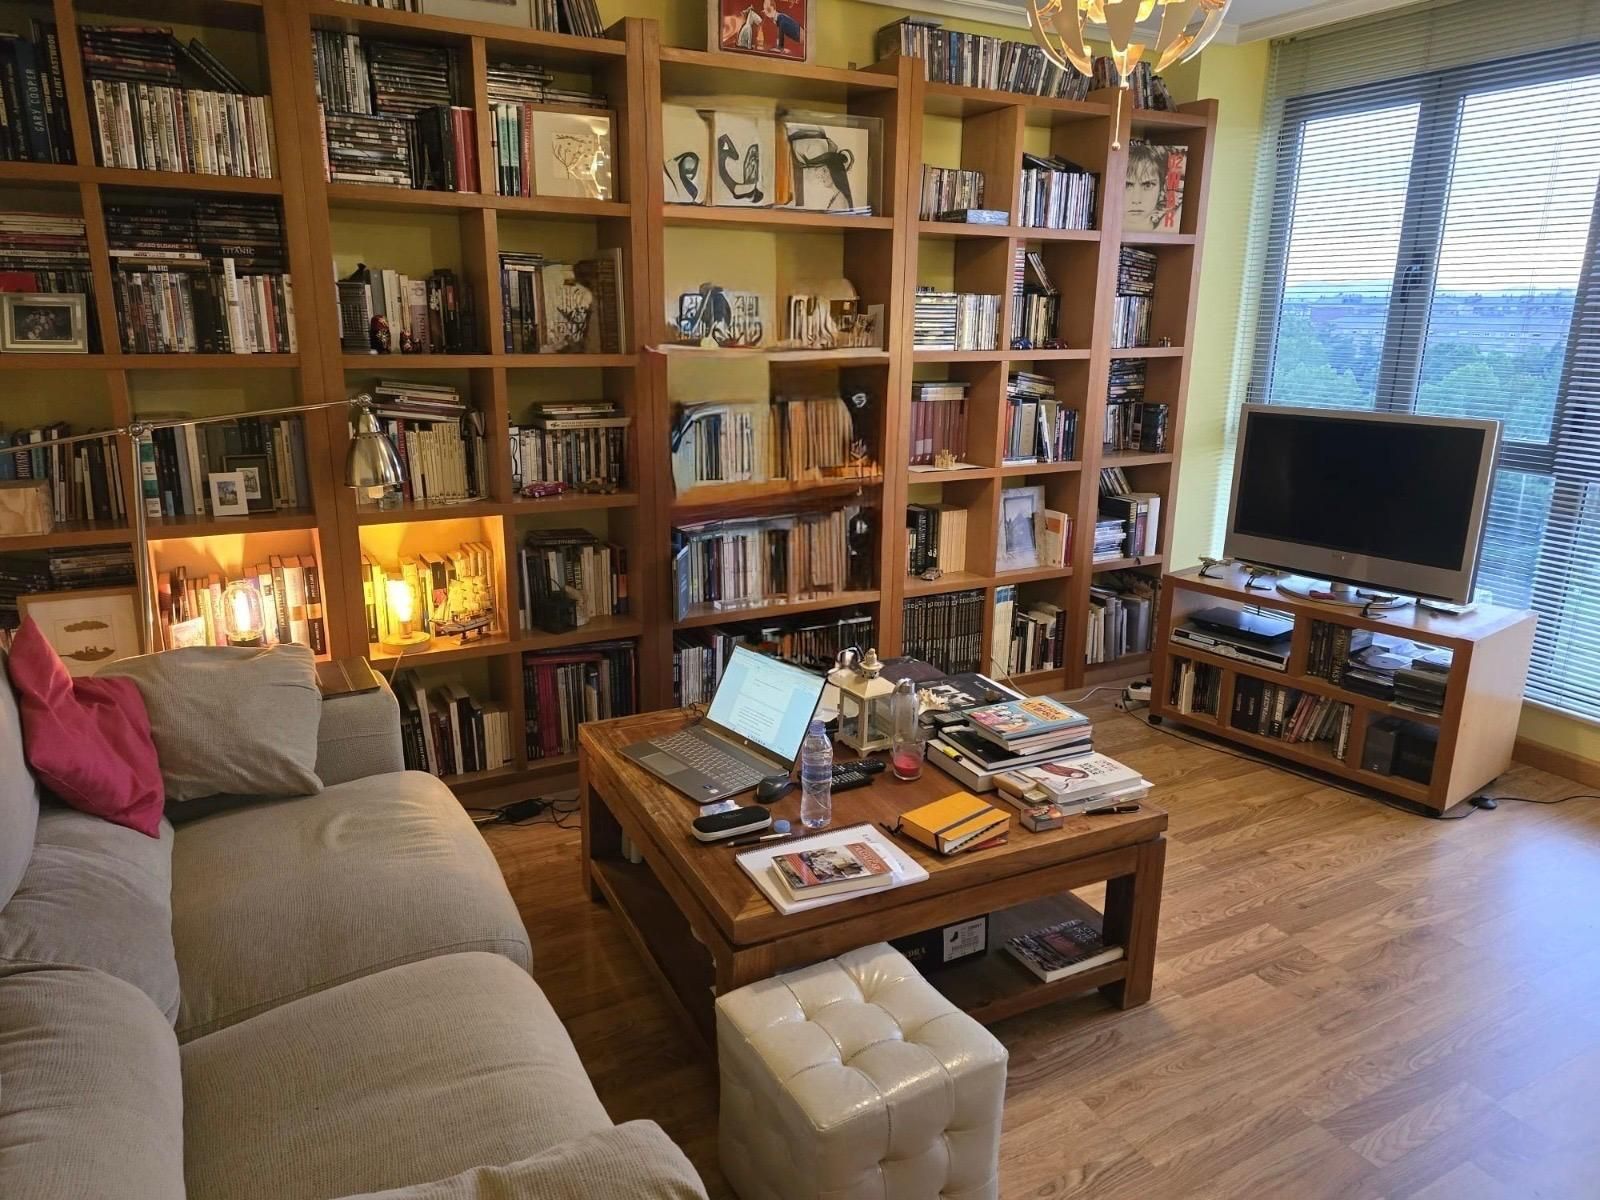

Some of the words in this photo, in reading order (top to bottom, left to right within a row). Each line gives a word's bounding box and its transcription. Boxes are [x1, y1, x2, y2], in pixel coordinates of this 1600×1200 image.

[25, 68, 40, 104] COOPER
[32, 109, 45, 132] GARY
[1167, 154, 1183, 169] U2
[222, 246, 256, 256] TITANIC
